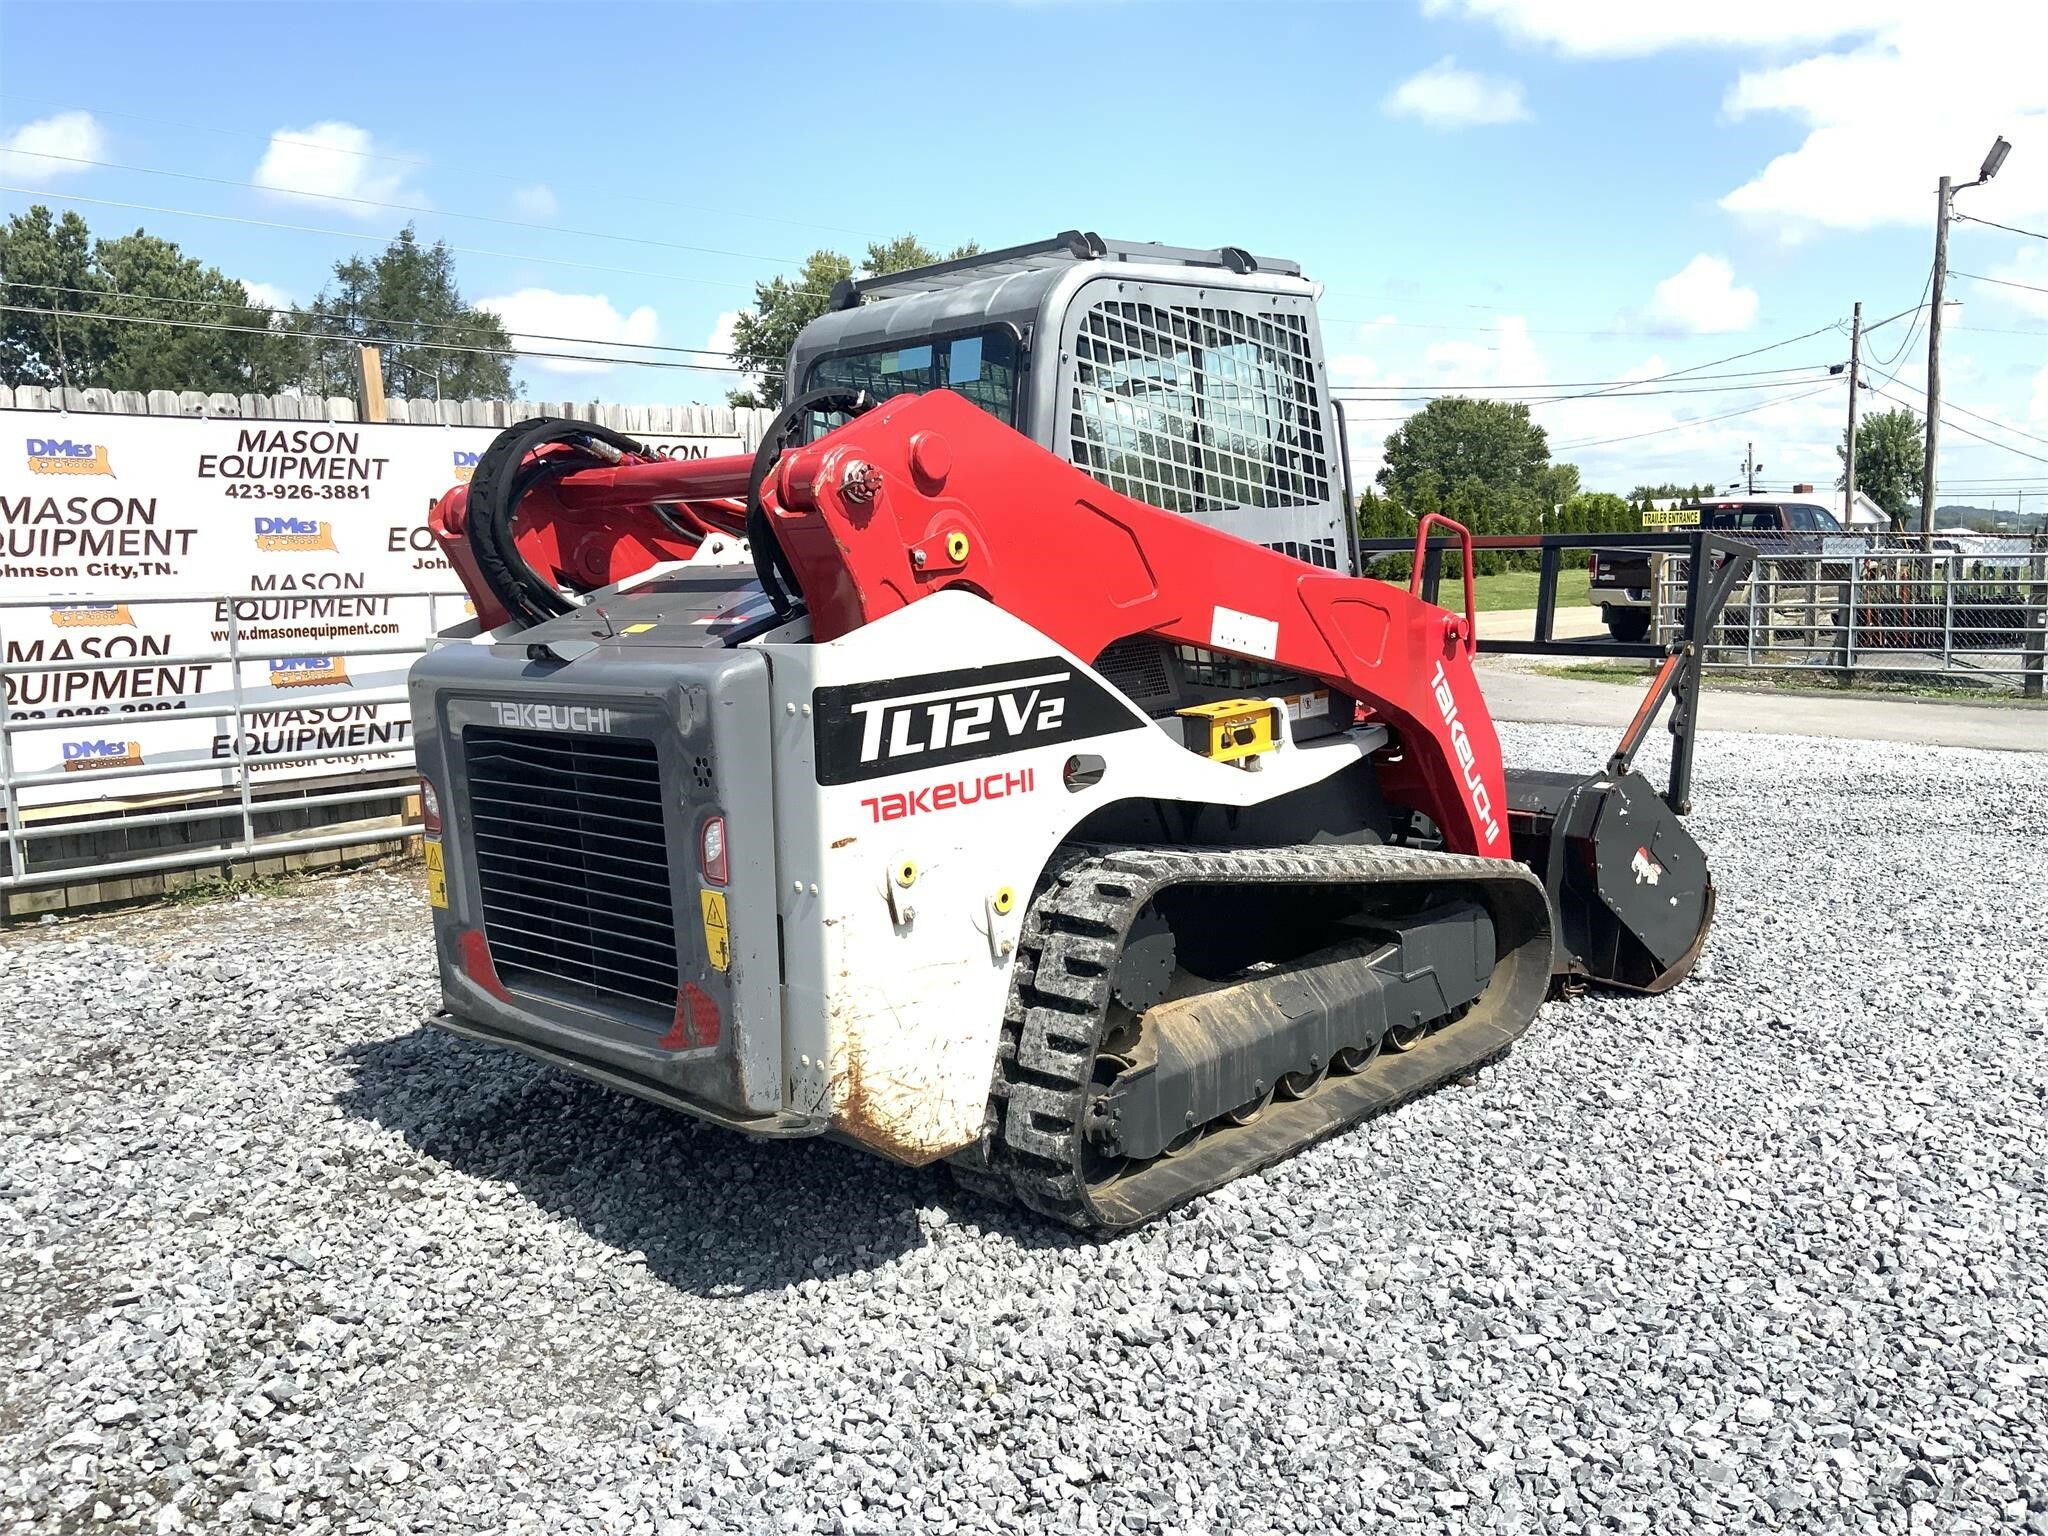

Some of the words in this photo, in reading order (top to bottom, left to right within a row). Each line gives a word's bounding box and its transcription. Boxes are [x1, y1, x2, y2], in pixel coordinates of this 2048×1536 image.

[237, 429, 359, 454] MASON
[656, 444, 708, 461] SON
[198, 455, 389, 480] EQUIPMENT
[225, 484, 370, 499] 423-926-3881
[0, 496, 157, 525] MASON
[1644, 513, 1668, 524] TRAILER
[1669, 512, 1698, 523] ENTRANCE
[0, 529, 198, 557] UIPMENT
[251, 572, 364, 591] MASON
[215, 598, 391, 622] EQUIPMENT
[6, 634, 171, 663] MASON
[251, 704, 378, 729] MASON
[851, 671, 1070, 763] TL12V2
[212, 720, 411, 759] EQUIPMENT
